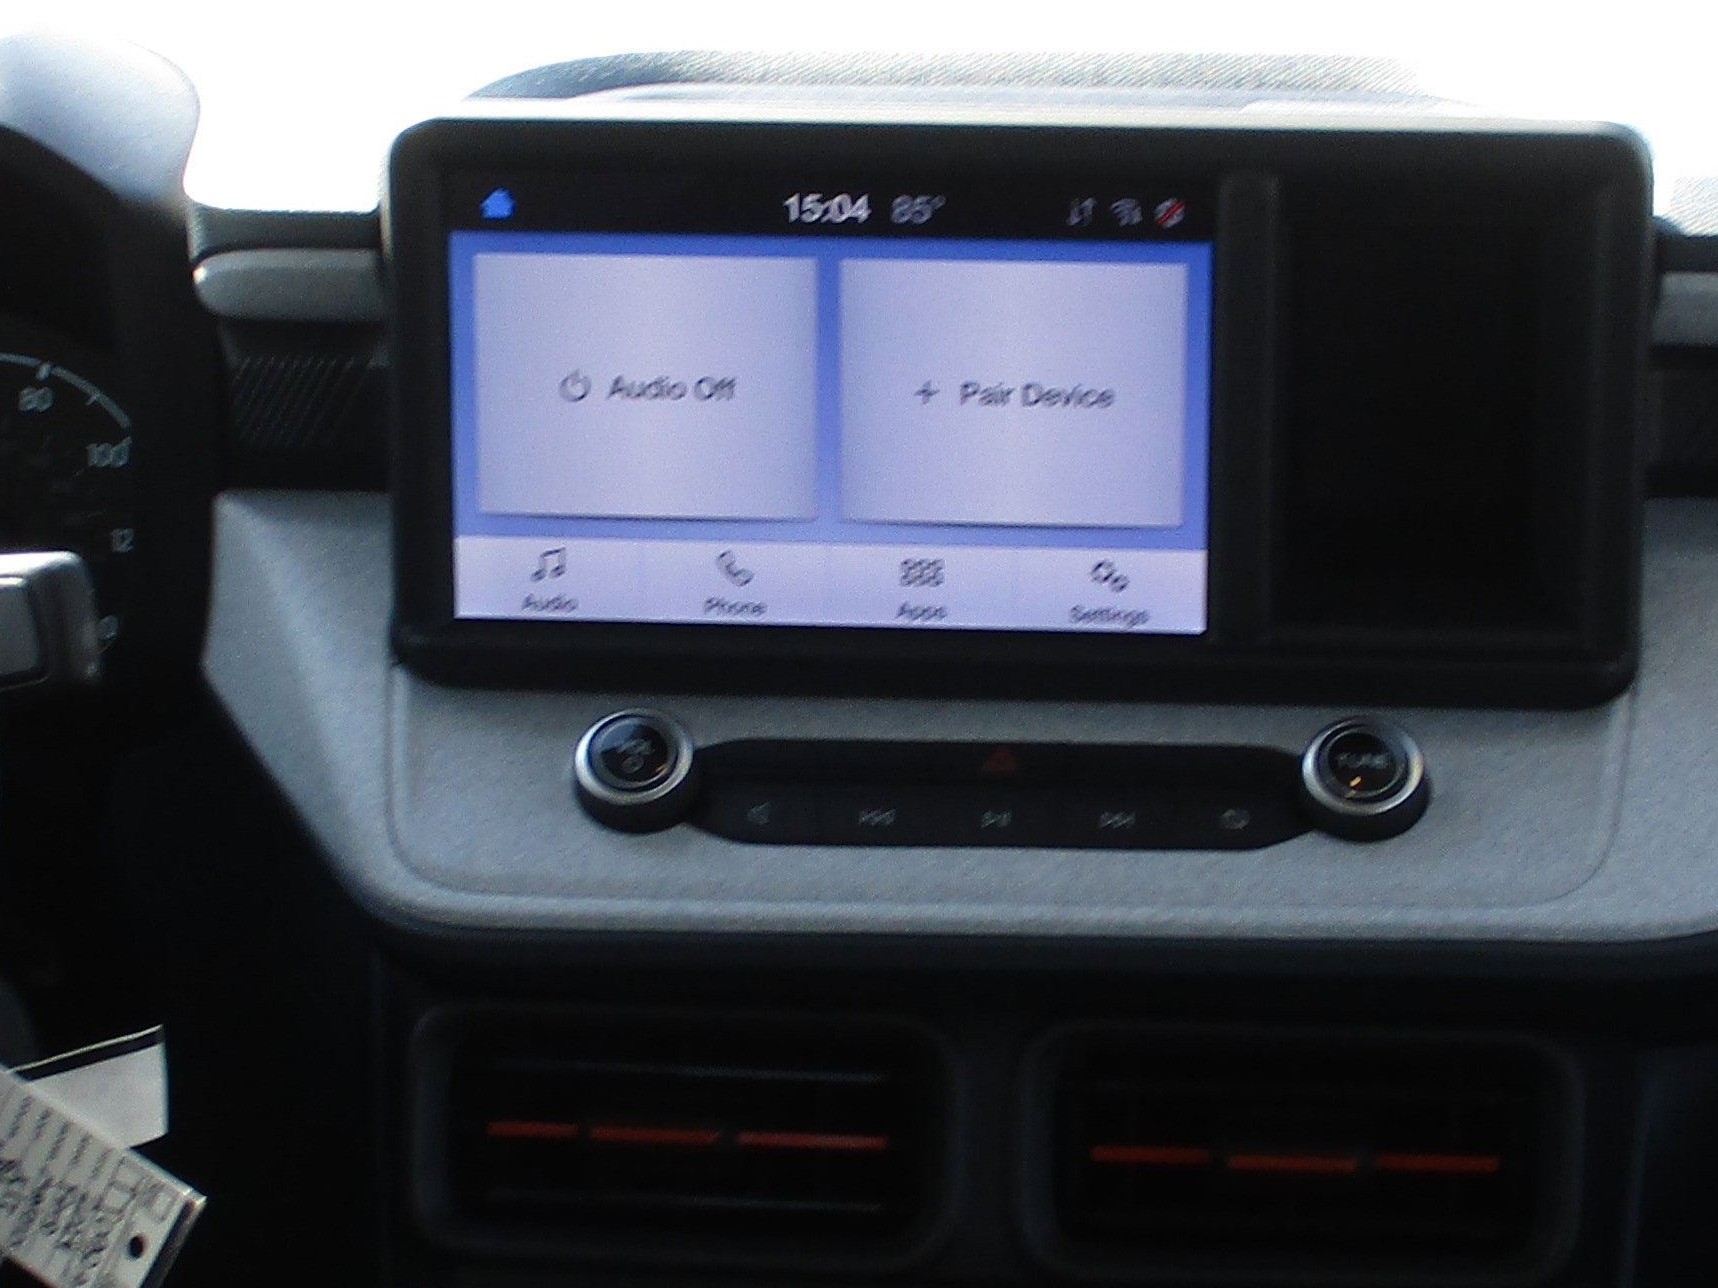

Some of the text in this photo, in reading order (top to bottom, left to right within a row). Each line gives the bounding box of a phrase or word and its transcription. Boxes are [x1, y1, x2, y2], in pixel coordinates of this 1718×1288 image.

[783, 192, 872, 224] 15:04
[605, 374, 737, 403] Audio Off
[958, 380, 1116, 409] Pair Device
